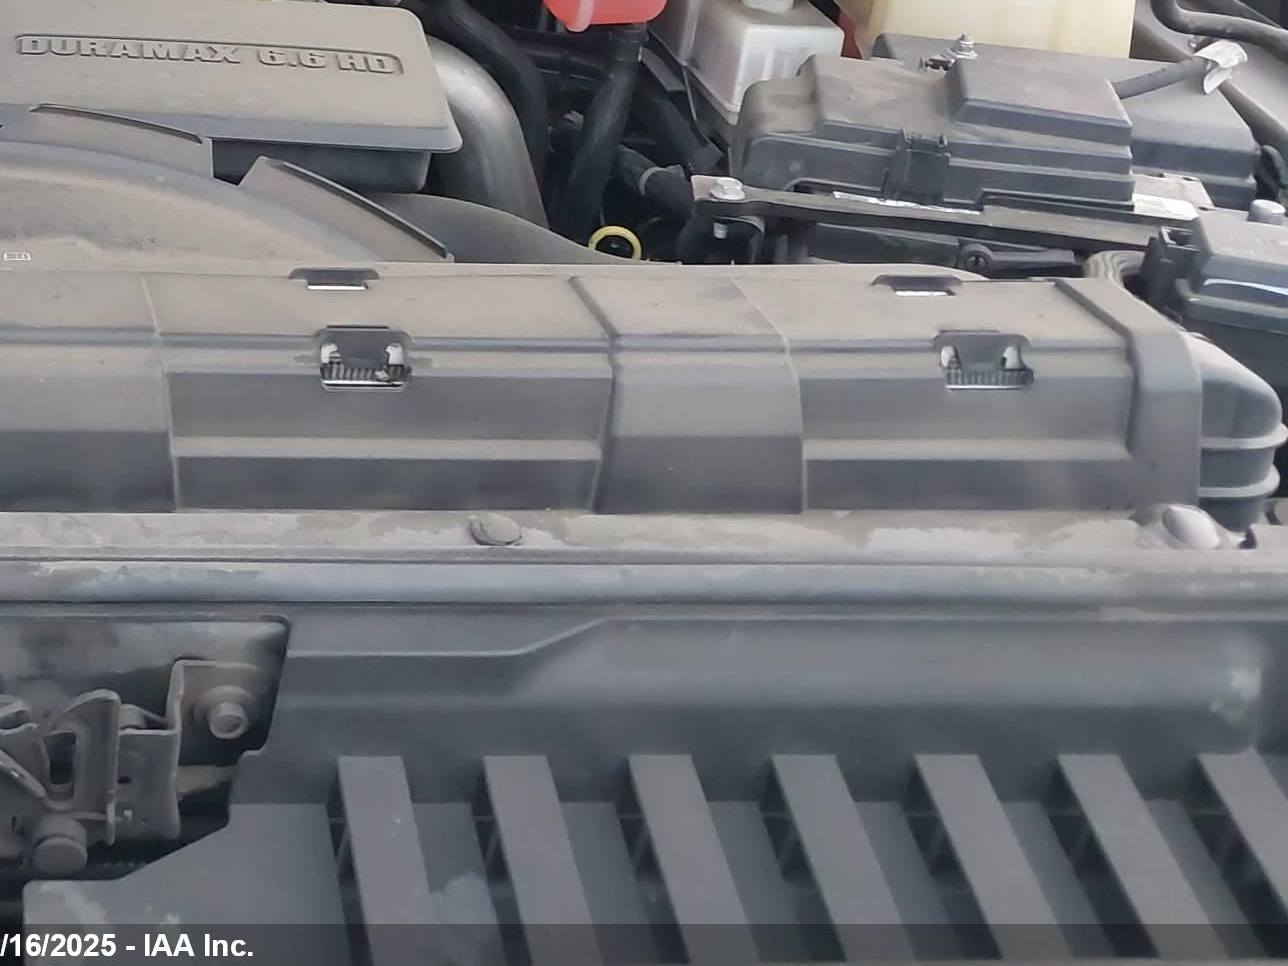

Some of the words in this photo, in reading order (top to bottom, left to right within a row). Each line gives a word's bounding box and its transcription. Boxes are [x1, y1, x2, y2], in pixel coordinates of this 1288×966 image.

[19, 35, 241, 64] DURAMAX
[258, 47, 327, 69] 6.6
[335, 52, 396, 74] HD
